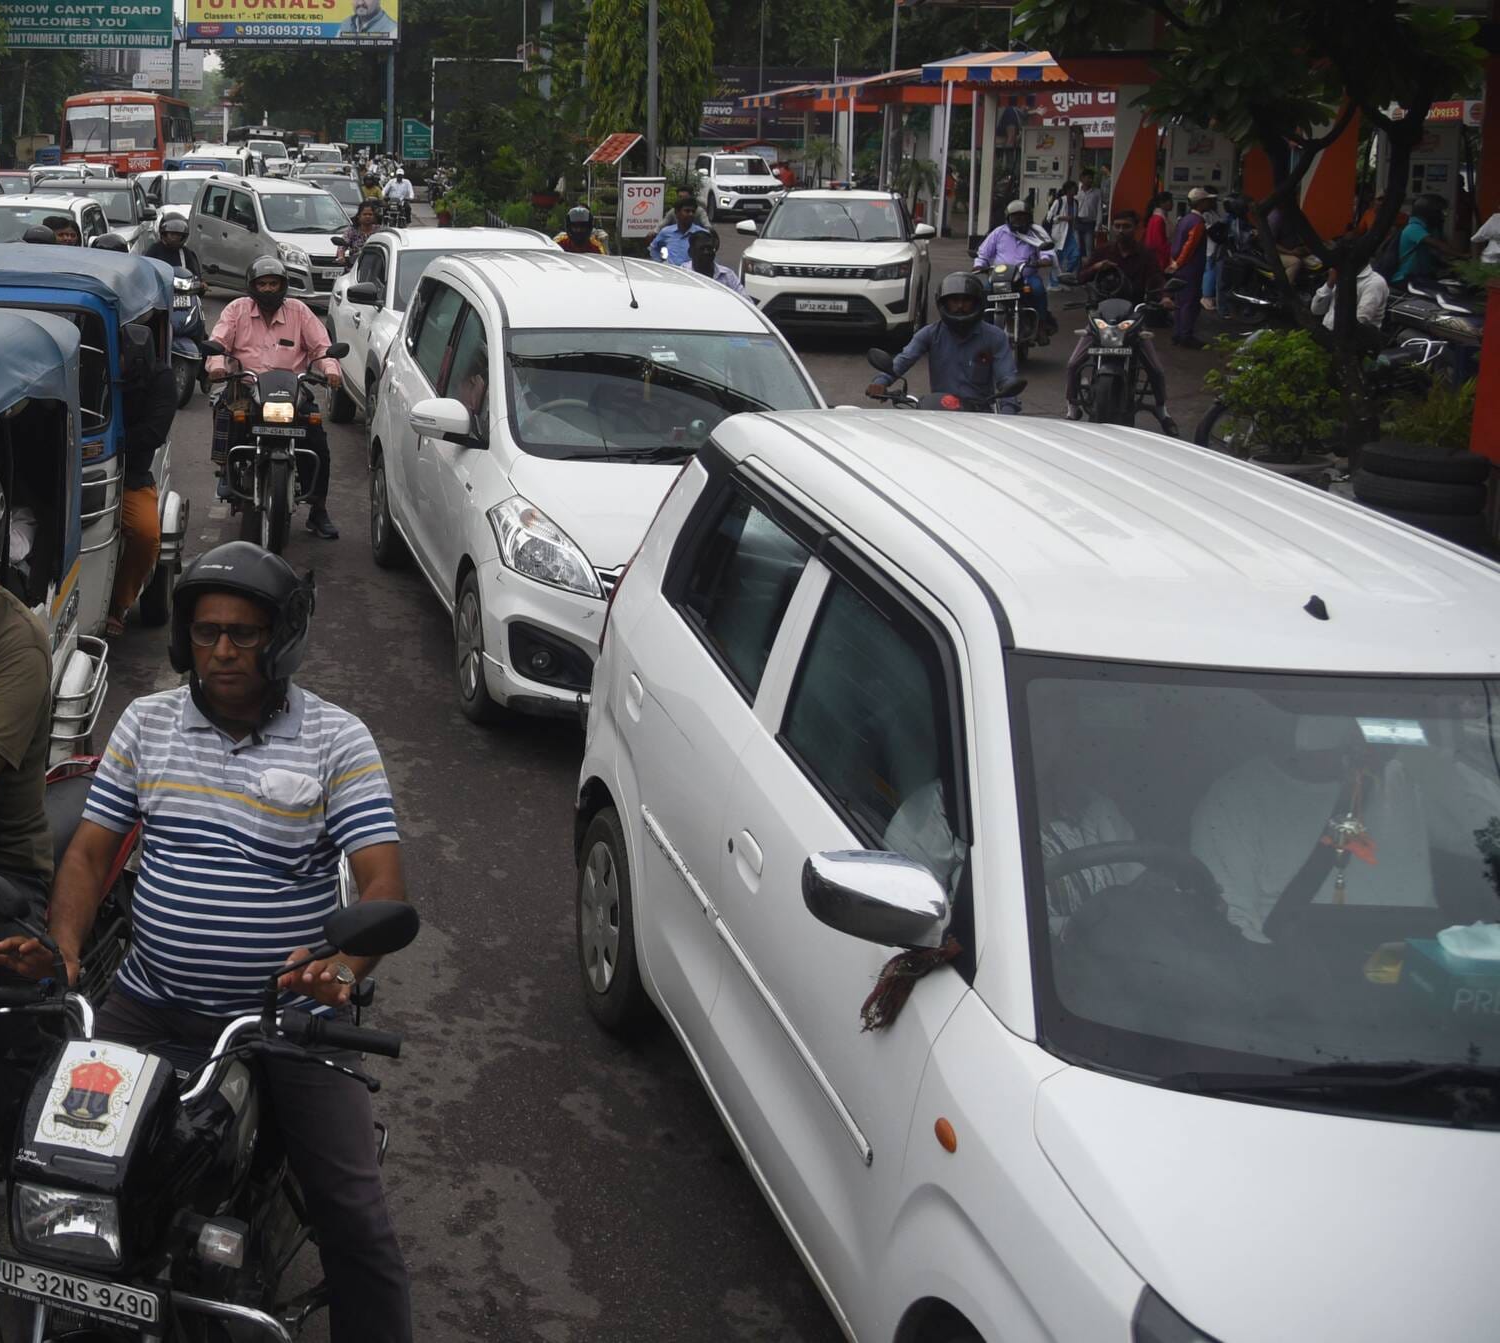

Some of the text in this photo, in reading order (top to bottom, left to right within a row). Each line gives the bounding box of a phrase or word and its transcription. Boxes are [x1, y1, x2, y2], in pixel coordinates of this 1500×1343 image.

[54, 5, 105, 14] CANTT
[110, 6, 162, 15] BOARD
[203, 12, 236, 20] Classes:
[8, 17, 126, 27] WELCOMES YOU
[245, 25, 322, 36] 9936093753
[7, 33, 169, 46] ANTONMENT, GREEN CANTONMENT
[702, 107, 733, 115] SERVO
[627, 187, 661, 198] STOP
[1, 1261, 25, 1285] UP
[36, 1272, 88, 1302] 32NS
[99, 1287, 152, 1318] 9490
